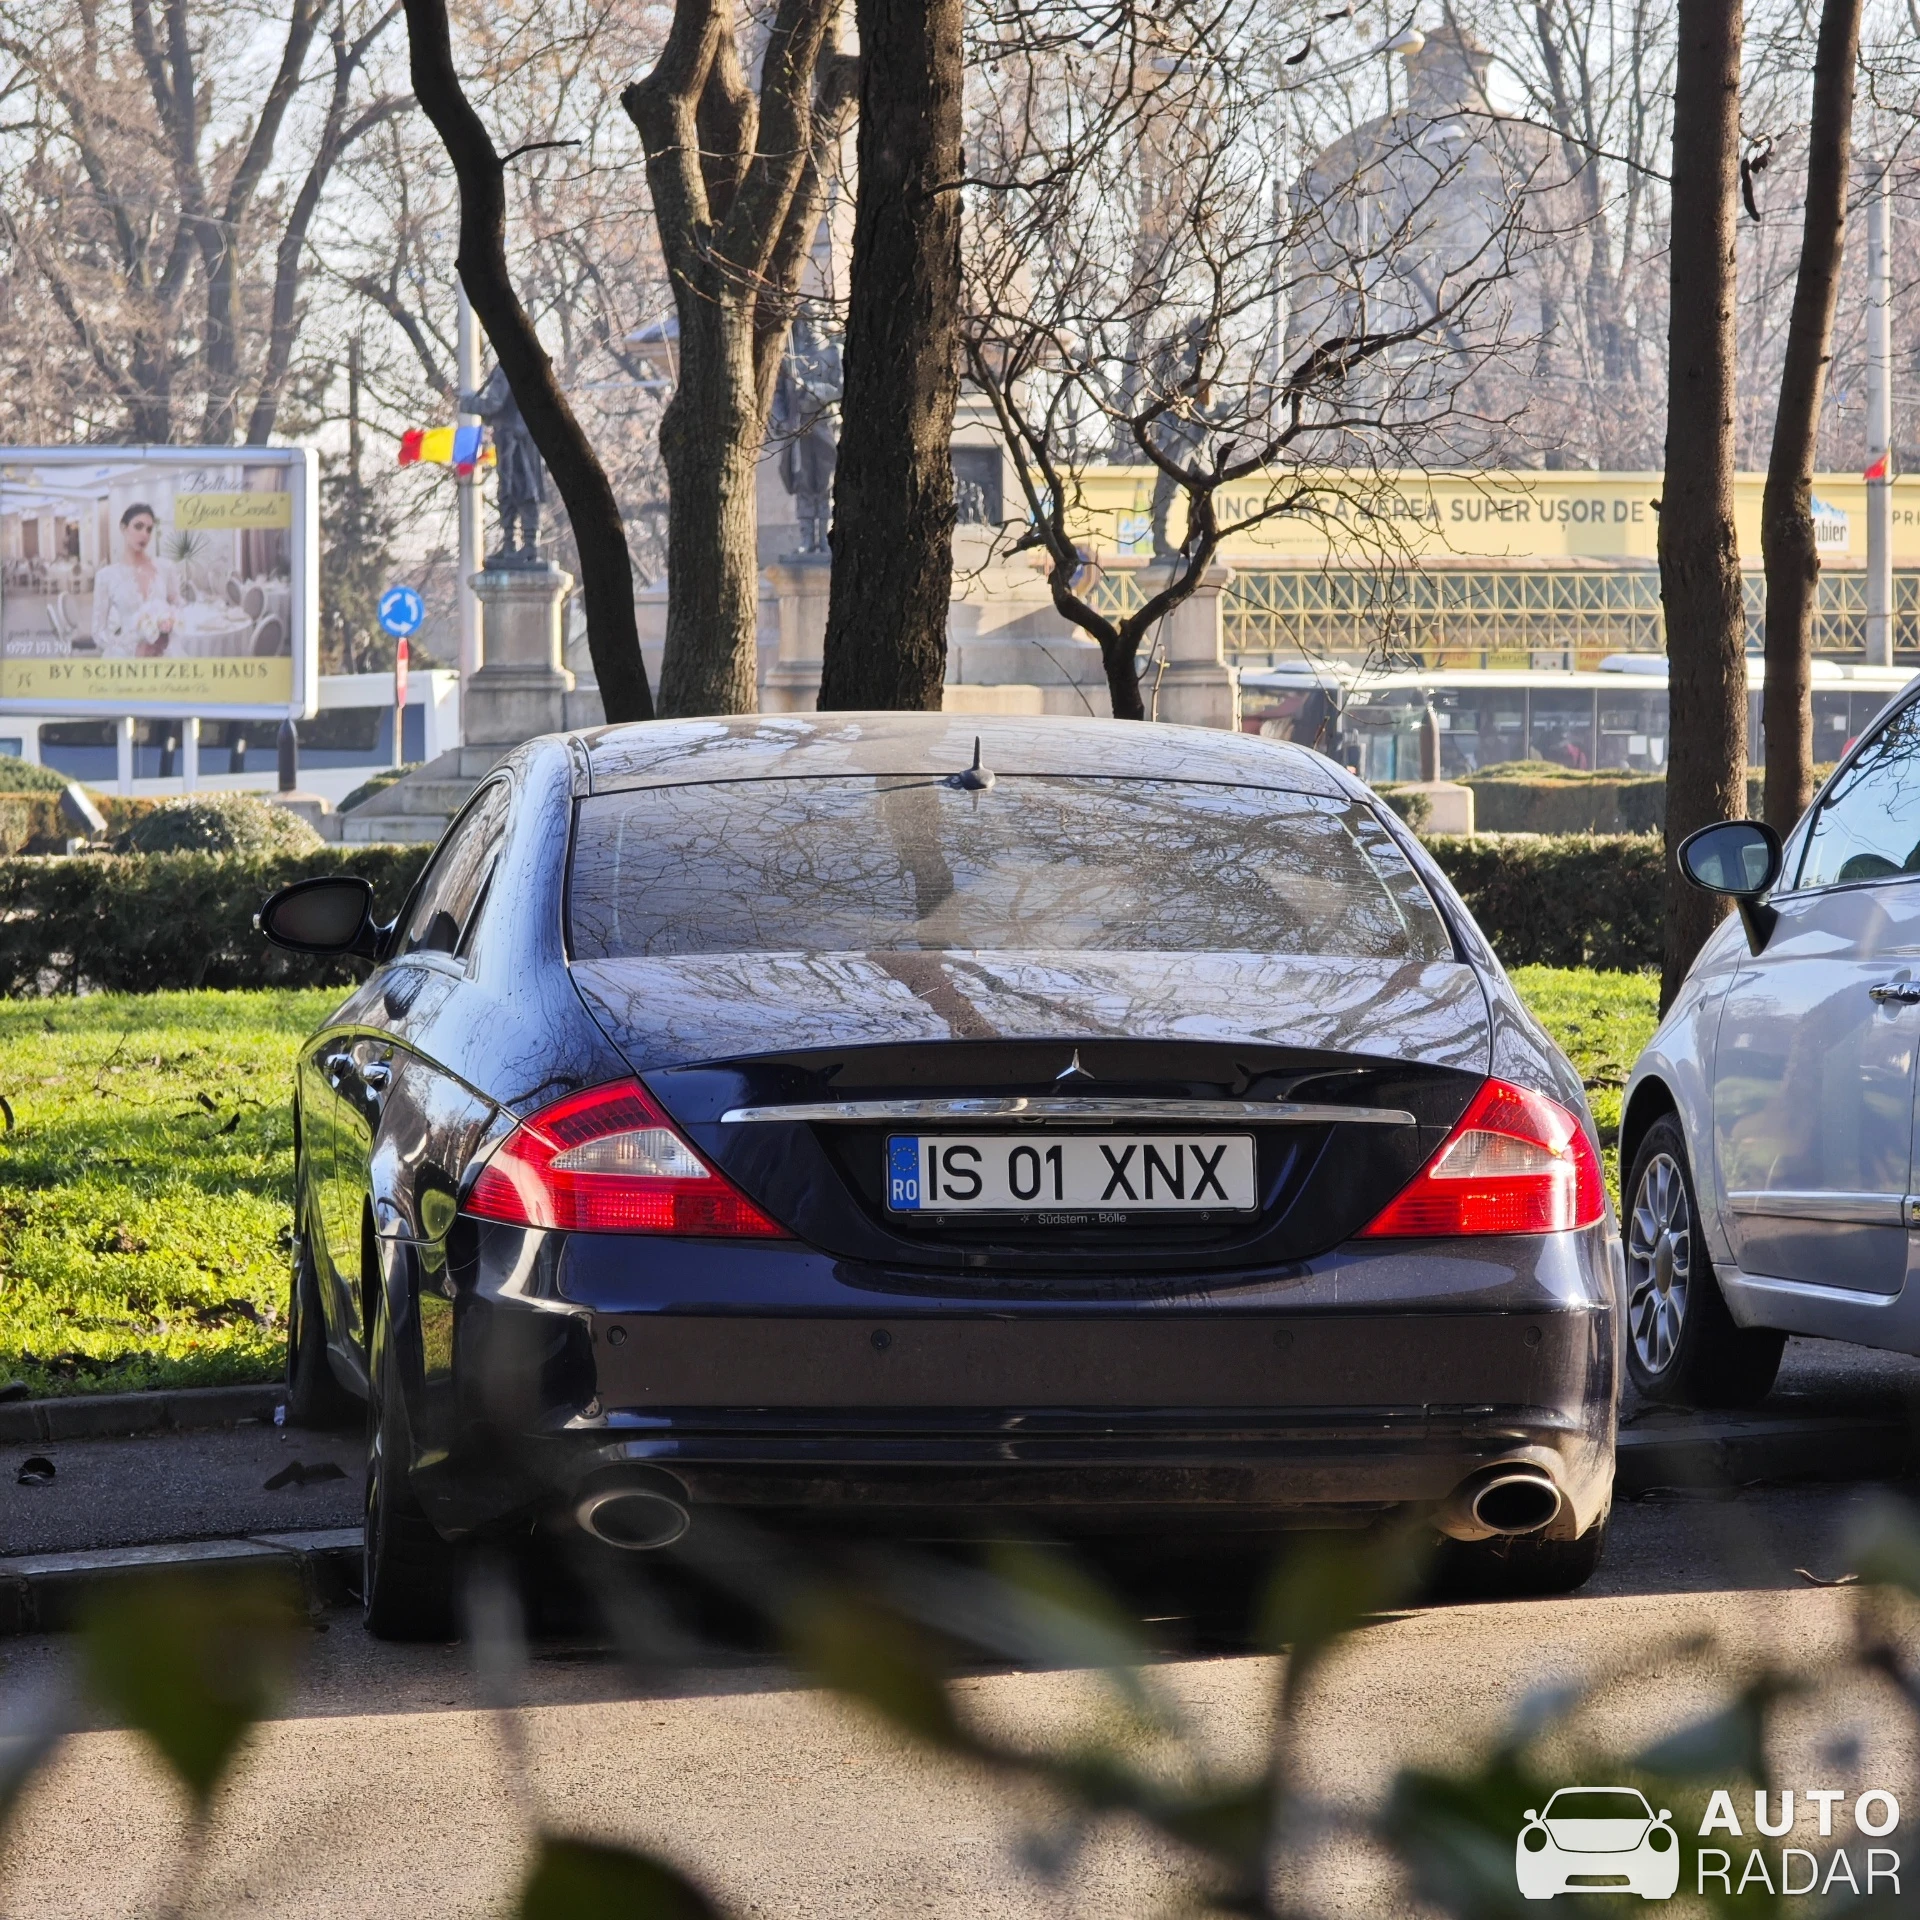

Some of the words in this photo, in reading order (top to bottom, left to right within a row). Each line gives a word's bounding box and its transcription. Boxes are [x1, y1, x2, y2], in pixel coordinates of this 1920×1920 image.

[1360, 498, 1442, 521] BEREA
[1451, 499, 1530, 522] SUPER
[1540, 499, 1606, 533] UȘOR
[1613, 501, 1645, 523] DE
[50, 664, 75, 680] BY
[83, 663, 205, 680] SCHNITZEL
[212, 662, 269, 679] HAUS
[927, 1145, 983, 1201] IS
[1008, 1145, 1063, 1201] 01
[1100, 1144, 1229, 1201] XNX
[893, 1179, 917, 1201] RO
[1038, 1213, 1088, 1225] Südstern
